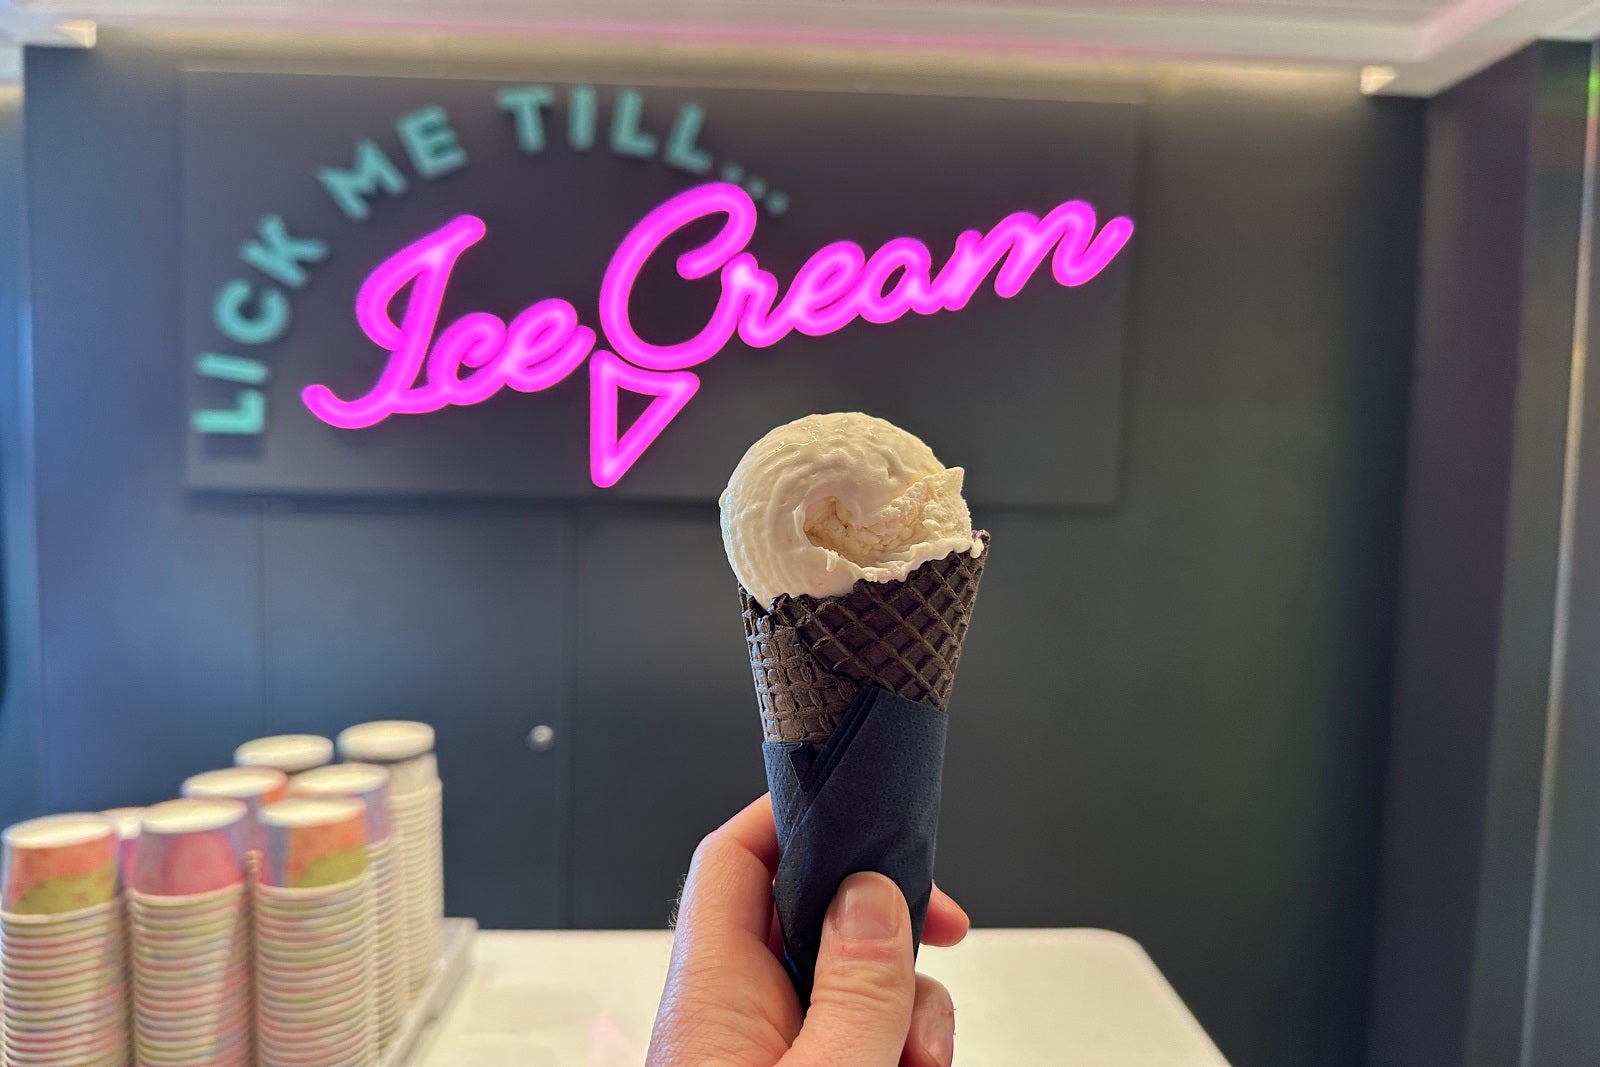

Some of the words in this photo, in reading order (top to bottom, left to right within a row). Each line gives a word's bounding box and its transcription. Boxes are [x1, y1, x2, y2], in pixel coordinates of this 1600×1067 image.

[192, 215, 327, 436] LICK
[317, 107, 467, 220] ME
[301, 214, 597, 430] Ice
[599, 182, 1135, 371] Cream
